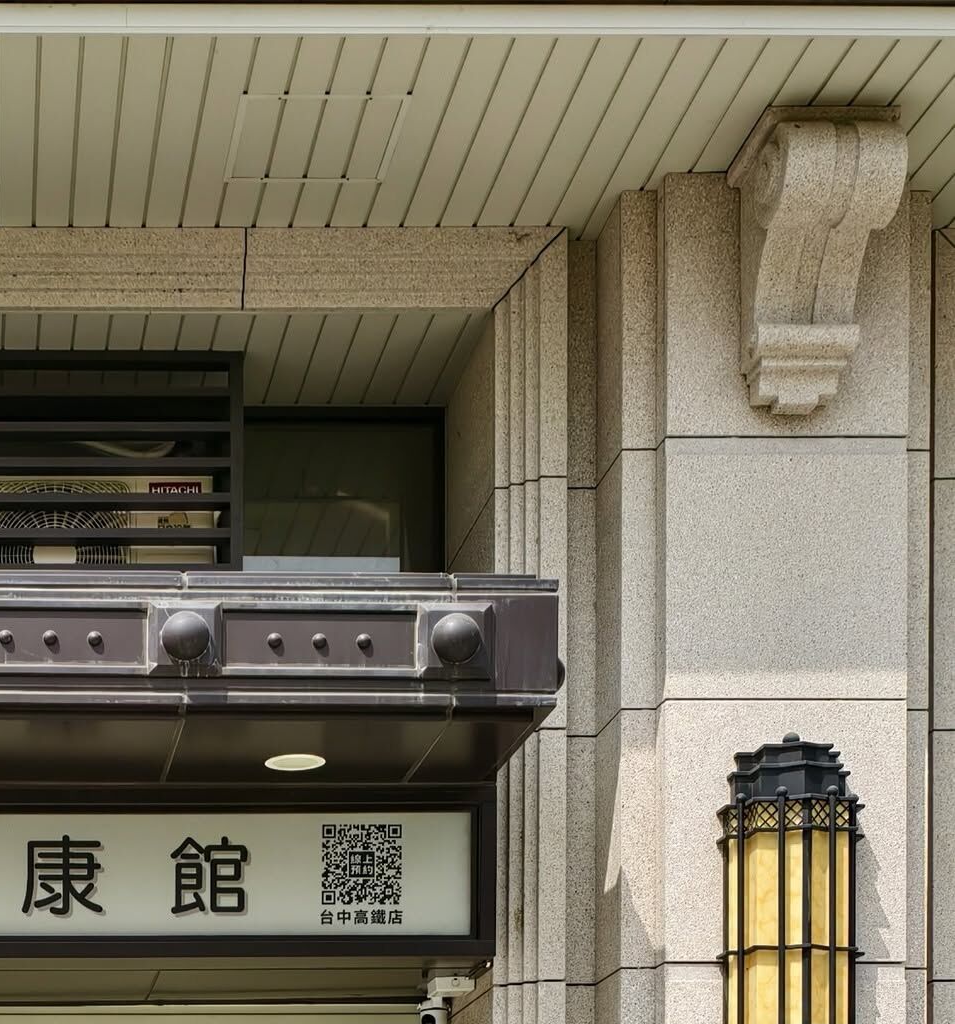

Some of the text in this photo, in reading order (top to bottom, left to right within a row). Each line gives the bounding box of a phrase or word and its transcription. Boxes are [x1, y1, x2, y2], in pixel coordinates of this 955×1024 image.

[151, 485, 199, 494] HITACHI
[351, 854, 373, 864] 線上
[351, 865, 373, 875] 預約
[320, 909, 403, 925] 台中高鐵店
